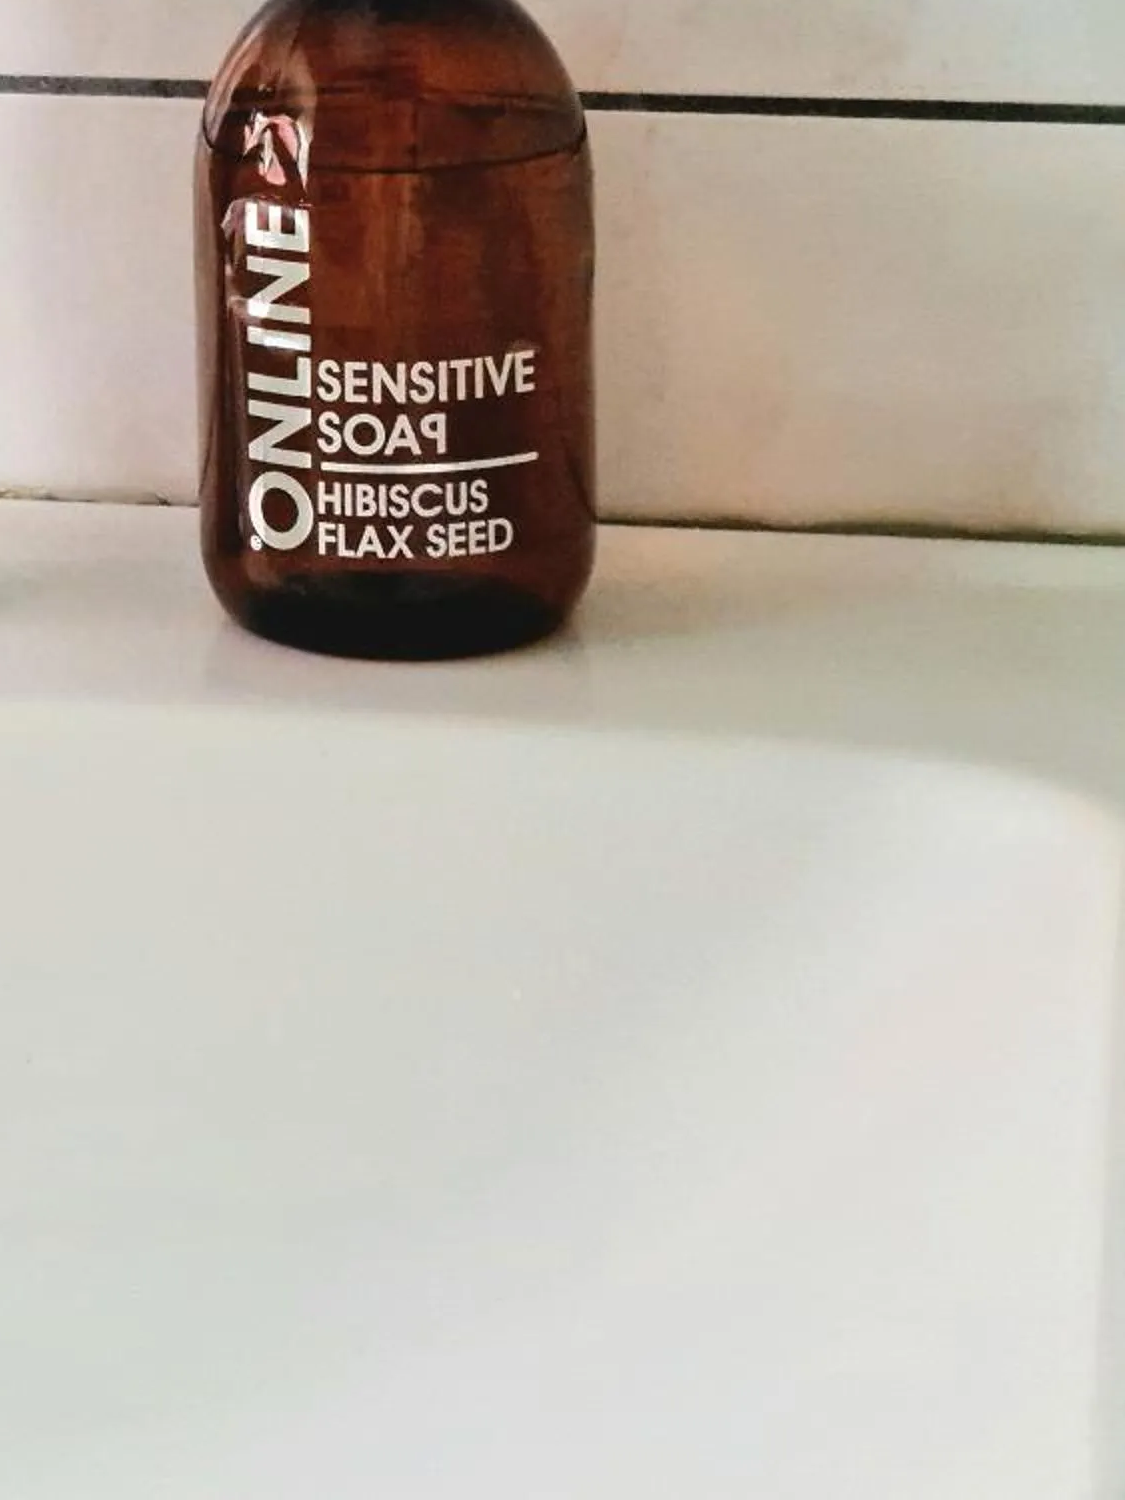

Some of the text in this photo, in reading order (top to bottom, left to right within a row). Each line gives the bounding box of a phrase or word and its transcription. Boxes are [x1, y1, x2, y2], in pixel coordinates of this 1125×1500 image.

[246, 202, 313, 550] ONLINE
[317, 350, 535, 403] SENSITIVE
[317, 479, 489, 518] HIBISCUS
[317, 517, 514, 559] FLAX SEED
